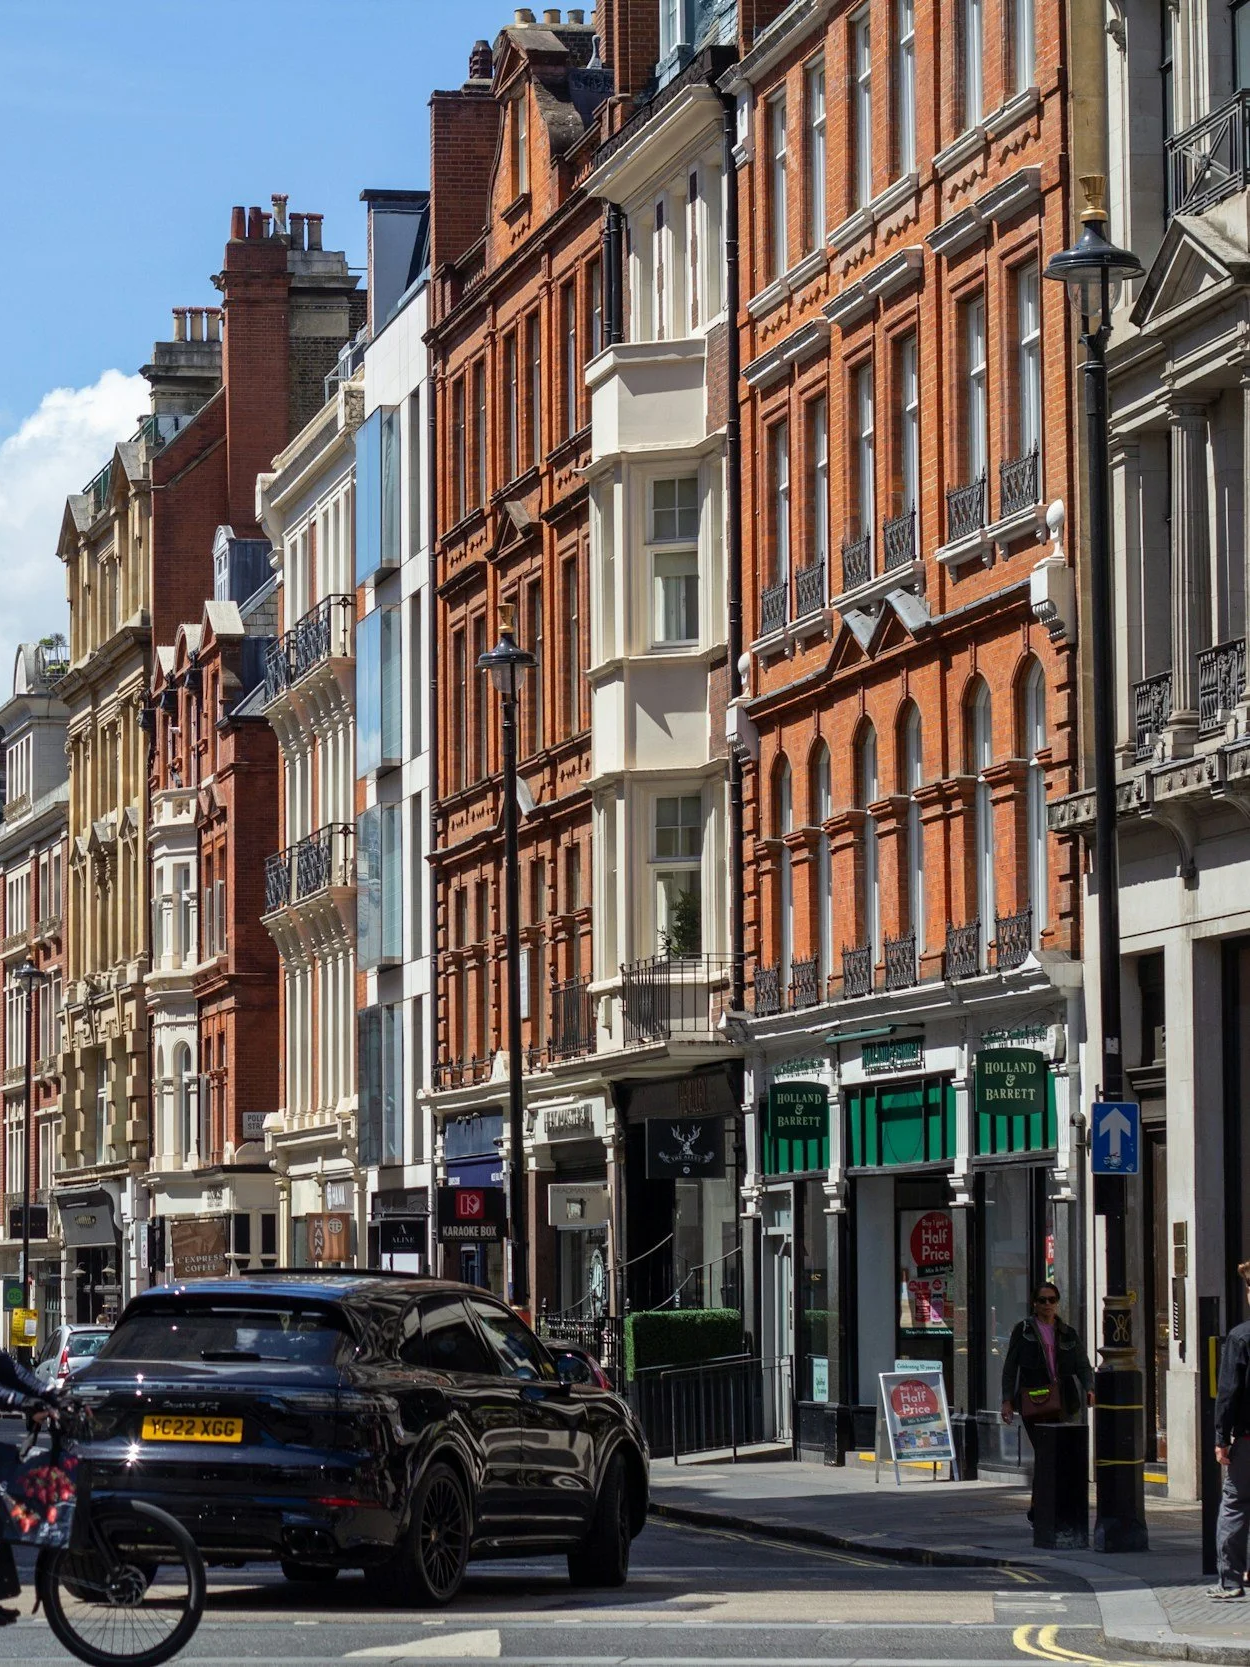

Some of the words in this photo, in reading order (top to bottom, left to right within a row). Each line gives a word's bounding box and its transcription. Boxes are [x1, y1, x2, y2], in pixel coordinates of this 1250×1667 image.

[984, 1061, 1037, 1075] HOLLAND
[1005, 1073, 1016, 1087] &
[776, 1093, 822, 1105] HOLLAND
[985, 1088, 1036, 1101] BARRETT
[794, 1104, 804, 1116] &
[247, 1114, 267, 1122] POLL
[777, 1116, 822, 1128] BARRETT
[921, 1218, 932, 1227] Buy
[442, 1225, 480, 1237] KARAOKE
[480, 1225, 497, 1237] BOX
[921, 1229, 948, 1245] Half
[314, 1220, 323, 1256] HANA
[177, 1253, 225, 1265] L'EXPRESS
[921, 1246, 950, 1261] Price
[184, 1264, 217, 1273] COFFEE
[897, 1363, 920, 1371] Celebrating
[900, 1391, 927, 1403] Half
[902, 1403, 931, 1415] Price
[151, 1417, 196, 1436] YC22
[200, 1420, 235, 1438] XGG
